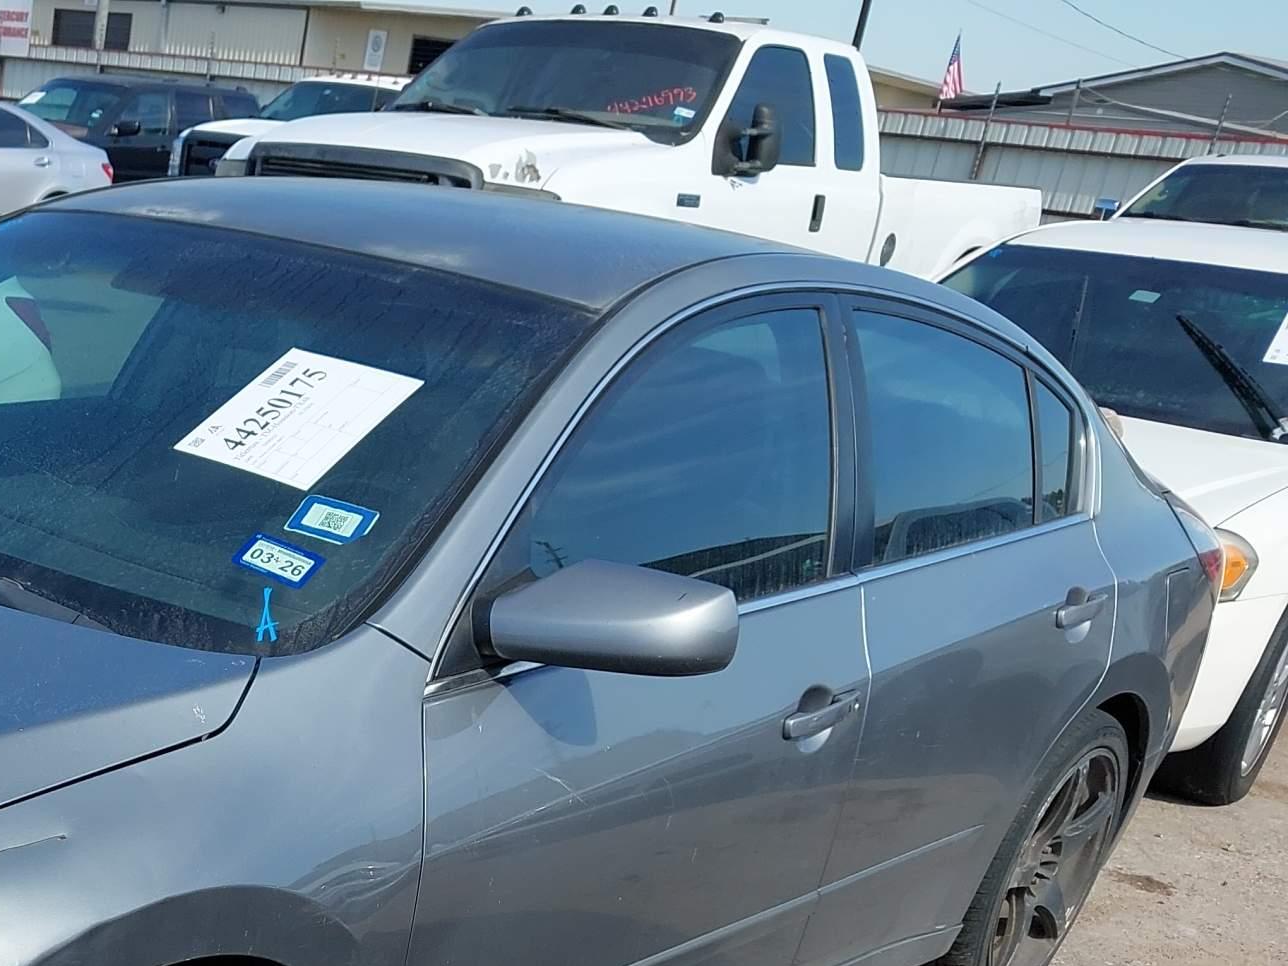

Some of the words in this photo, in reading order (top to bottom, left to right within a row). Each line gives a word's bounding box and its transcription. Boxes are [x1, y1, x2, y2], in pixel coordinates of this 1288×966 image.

[223, 367, 328, 452] 44250175
[250, 548, 274, 564] 03
[278, 560, 305, 577] 26
